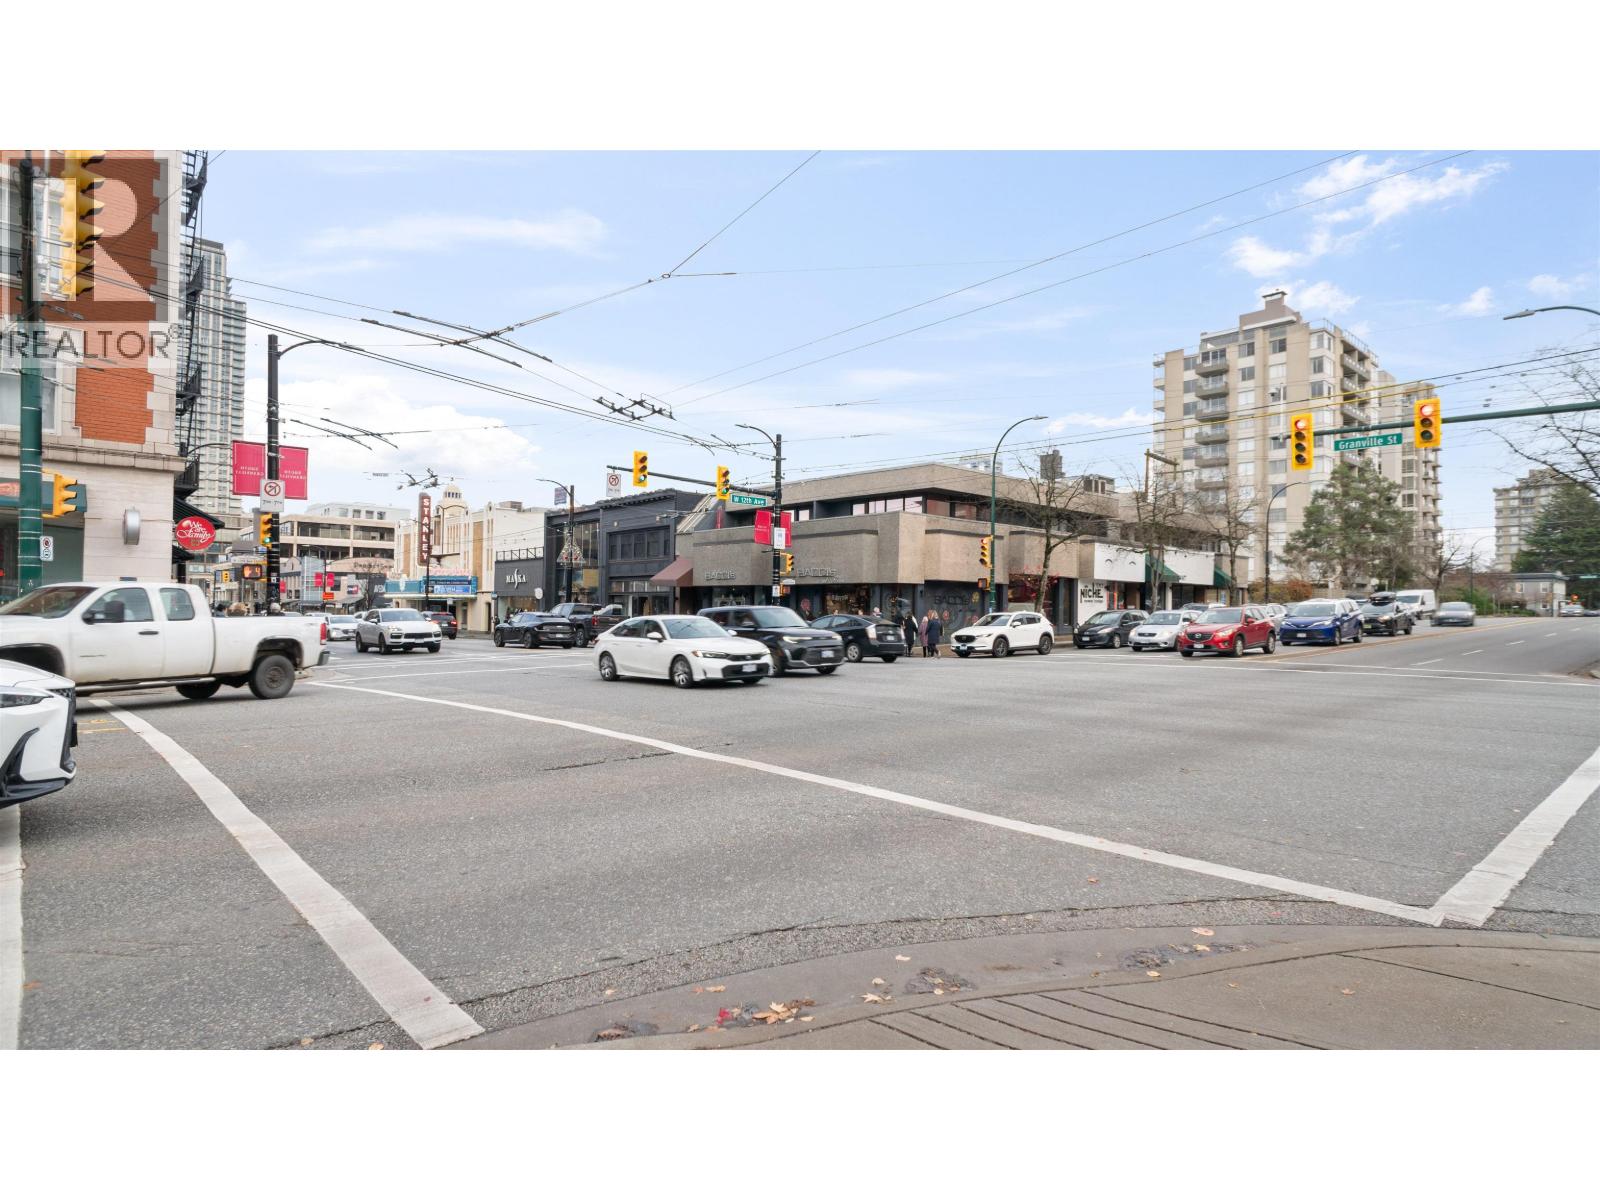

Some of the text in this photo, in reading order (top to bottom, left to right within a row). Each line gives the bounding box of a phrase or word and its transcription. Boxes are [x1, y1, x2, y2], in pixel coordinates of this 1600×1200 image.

[1338, 435, 1398, 450] Granville St
[733, 495, 740, 503] W
[754, 498, 765, 506] Ave
[186, 519, 203, 529] We
[422, 498, 430, 560] STANLEY
[177, 529, 215, 543] Family
